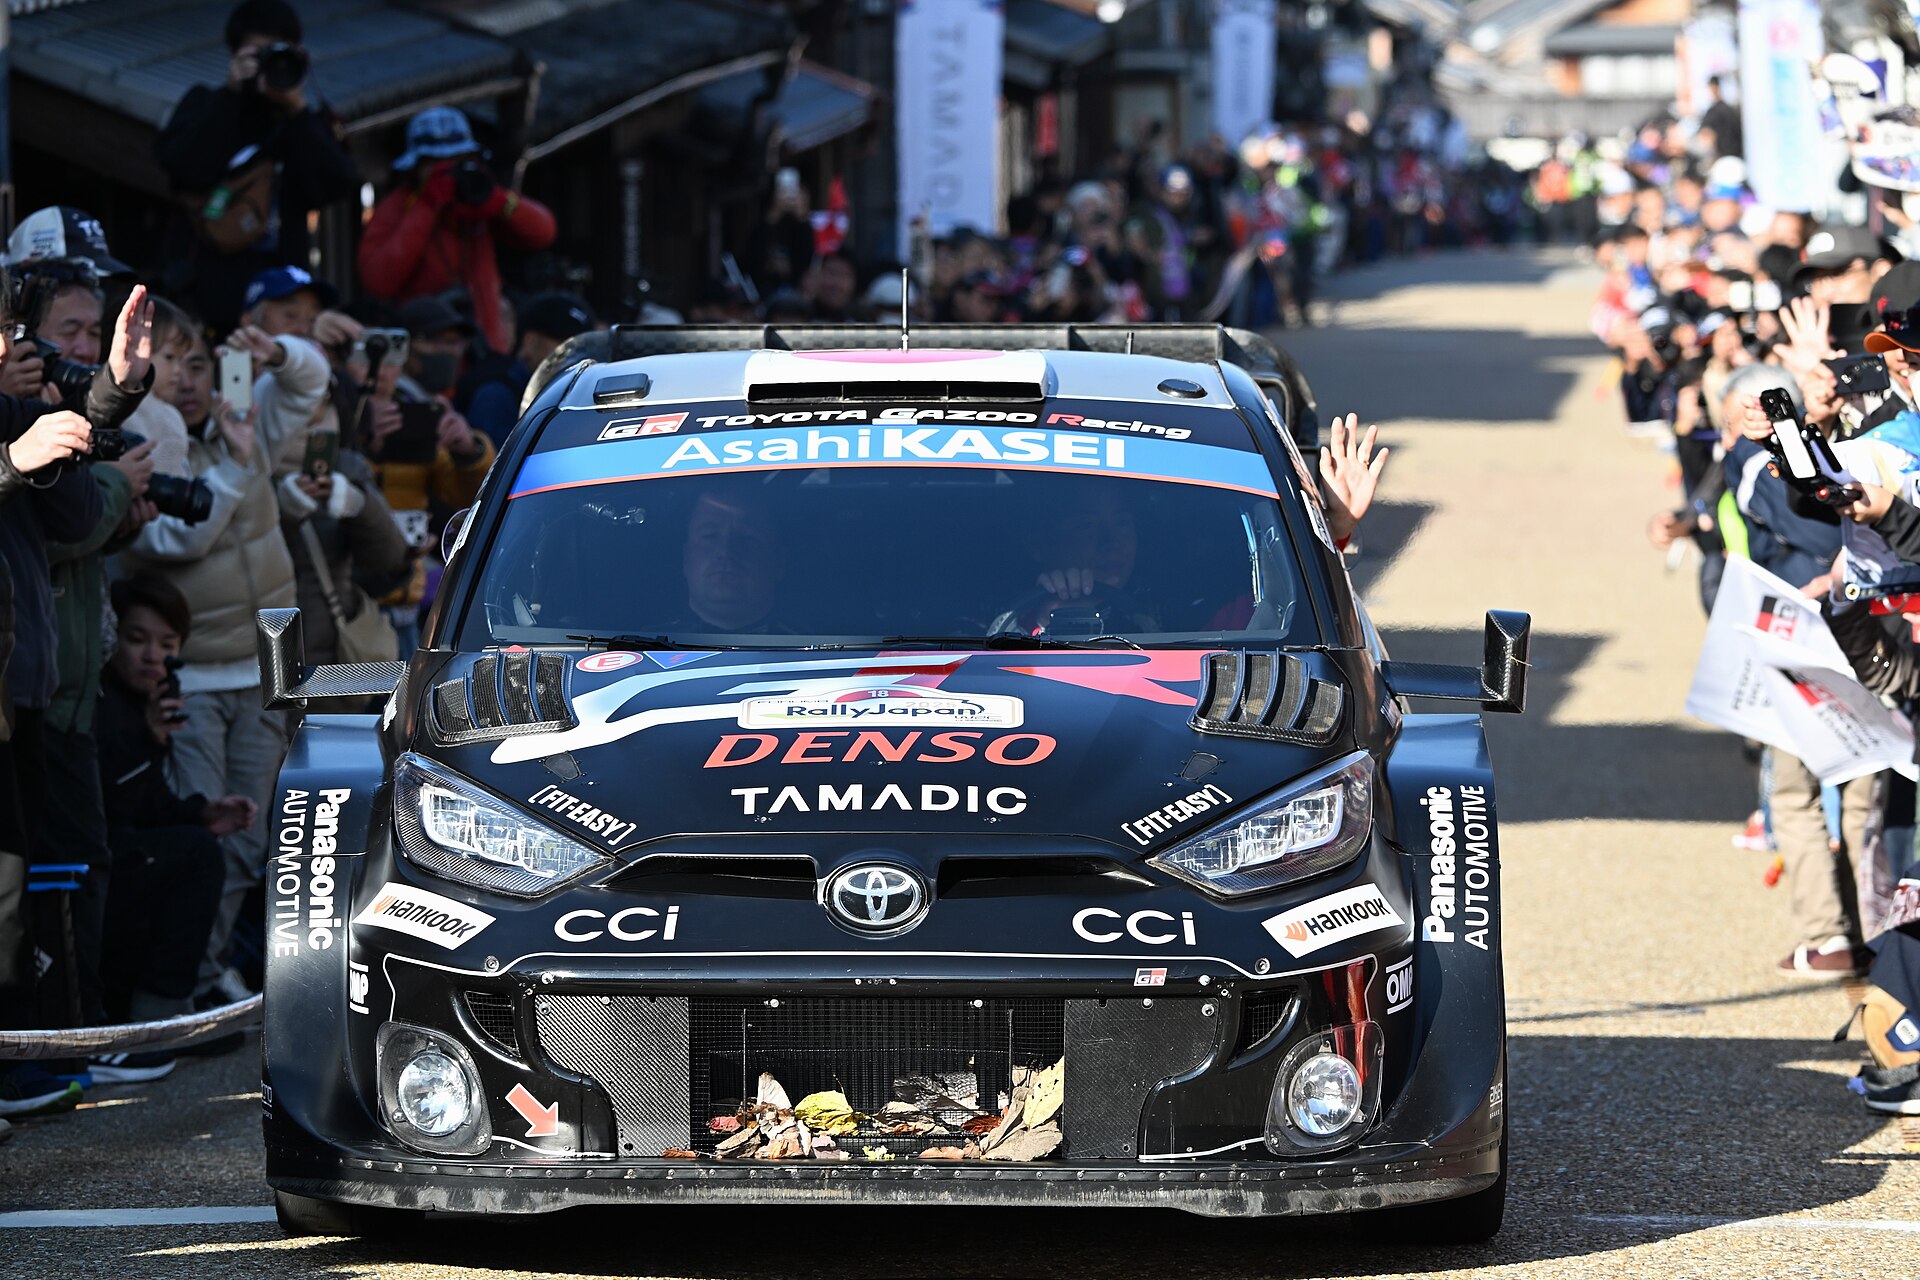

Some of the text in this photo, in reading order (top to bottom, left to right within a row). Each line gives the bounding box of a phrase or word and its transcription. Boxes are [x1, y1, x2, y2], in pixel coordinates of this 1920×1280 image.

[929, 24, 966, 208] TAMAD
[601, 418, 683, 439] GR
[696, 408, 1192, 440] TOYOTA GAZOO Racing
[596, 655, 624, 668] E
[867, 689, 890, 698] 18
[704, 731, 1056, 768] DENSO
[731, 784, 1027, 816] TAMADIC
[274, 789, 305, 957] AUTOMOTIVE
[307, 788, 352, 951] Panasonic
[1420, 786, 1457, 943] Panasonic
[1460, 785, 1490, 951] AUTOMOTIVE
[1136, 973, 1165, 985] GR
[1386, 964, 1413, 1004] OMP
